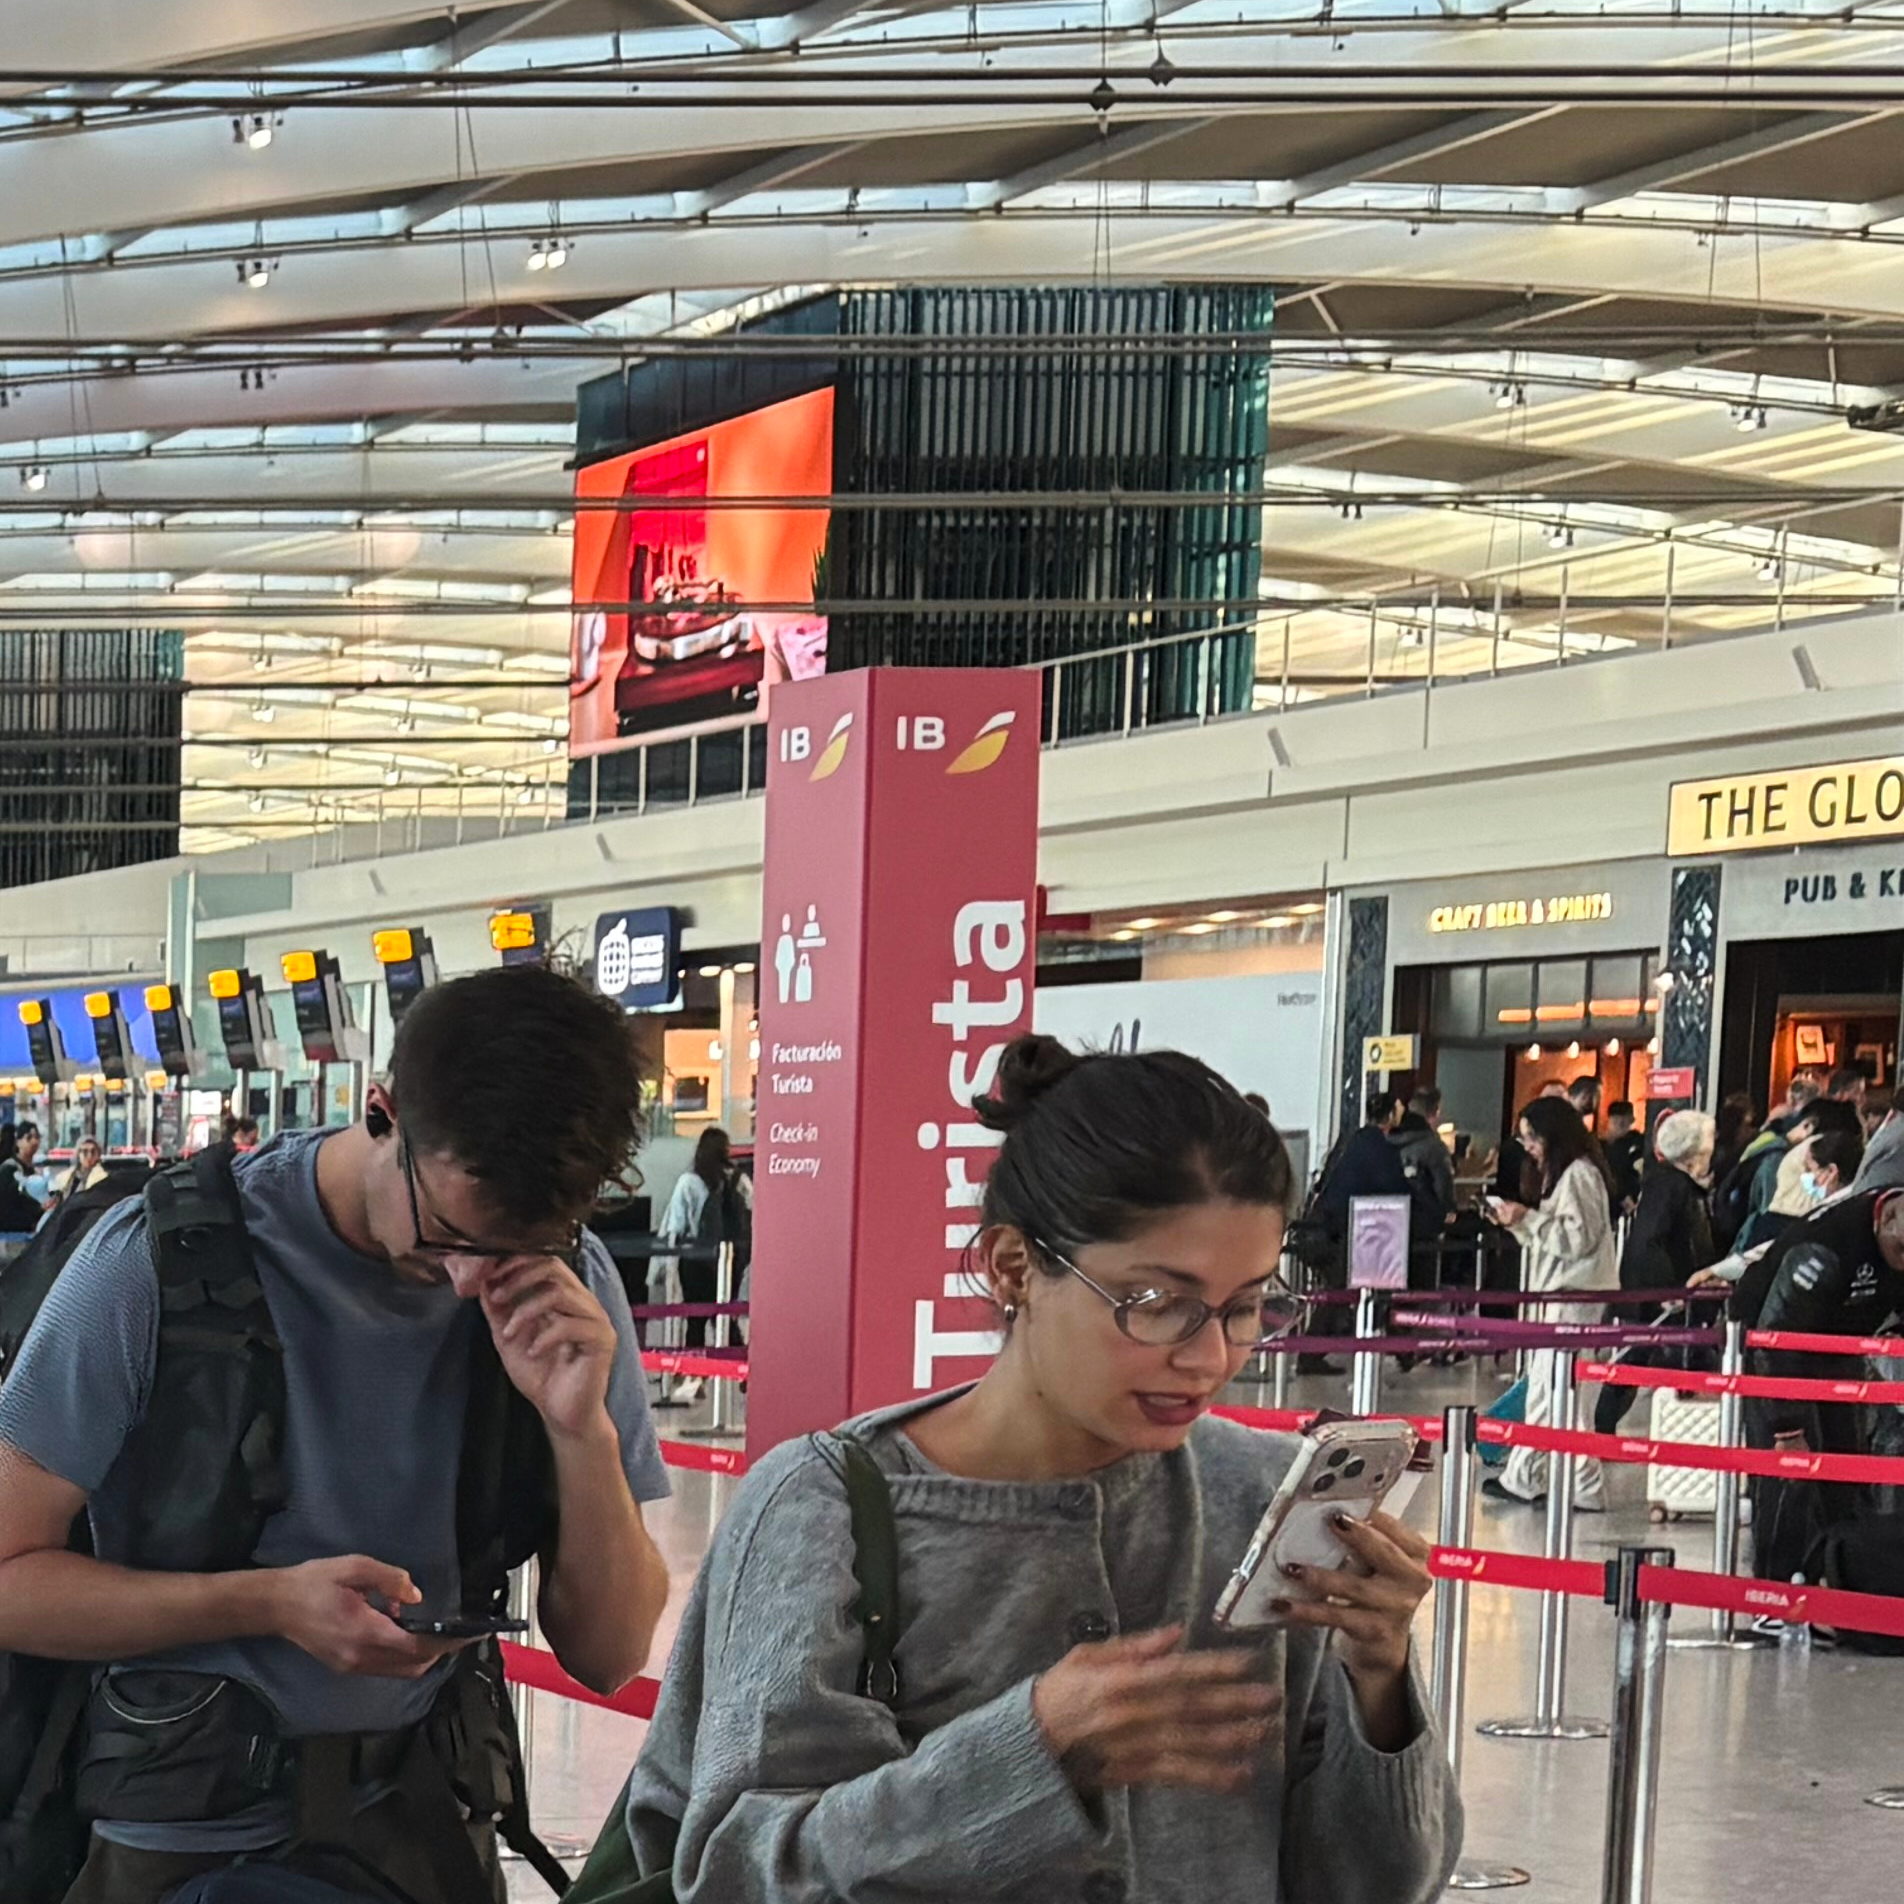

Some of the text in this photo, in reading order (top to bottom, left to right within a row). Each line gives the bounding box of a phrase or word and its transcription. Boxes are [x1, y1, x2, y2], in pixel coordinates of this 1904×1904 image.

[780, 726, 811, 762] IB
[896, 715, 946, 750] IB
[1698, 769, 1904, 840] THE GLO
[1784, 874, 1837, 904] PUB
[1848, 872, 1865, 899] &
[772, 1040, 842, 1064] Facturación
[772, 1073, 814, 1095] Turista
[770, 1122, 819, 1143] Check-in
[768, 1153, 821, 1178] Economy
[1744, 1589, 1790, 1607] IBERIA
